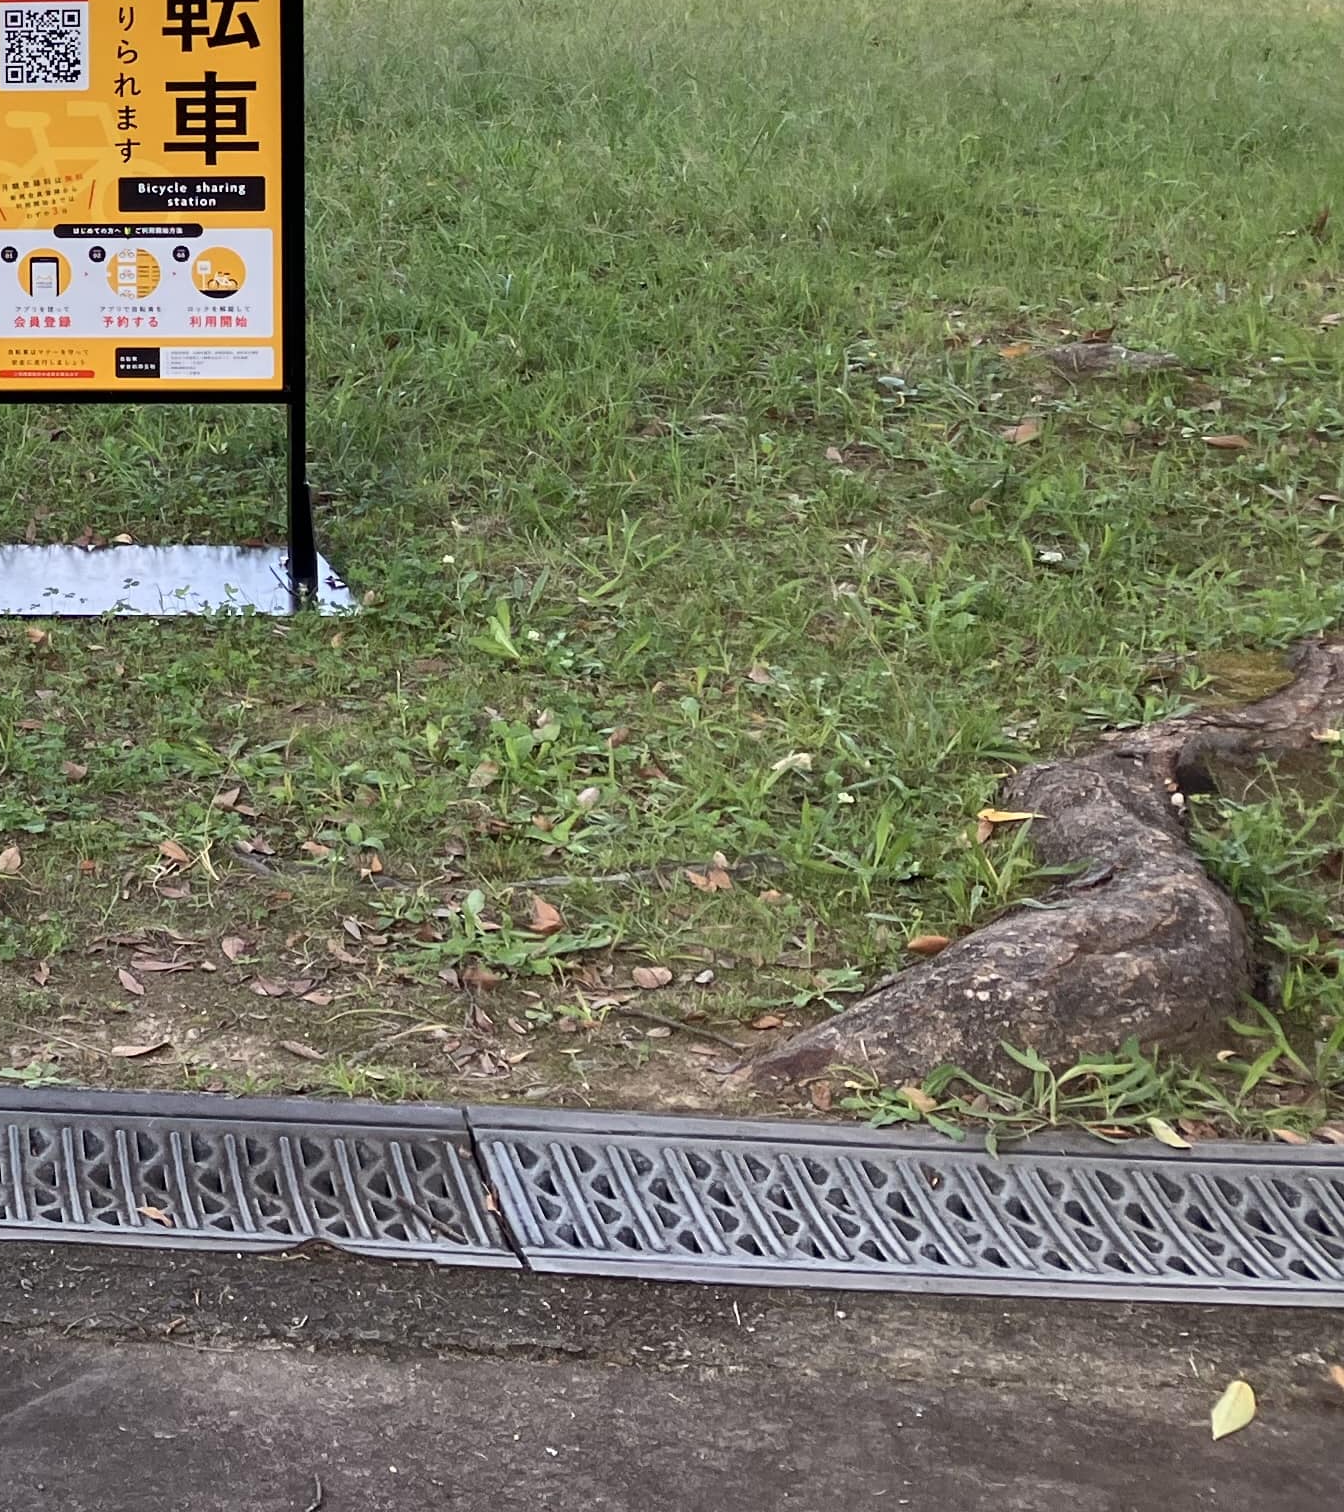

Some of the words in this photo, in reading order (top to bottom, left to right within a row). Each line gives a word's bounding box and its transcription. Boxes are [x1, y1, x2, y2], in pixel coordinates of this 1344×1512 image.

[138, 182, 188, 196] Bicycle
[195, 182, 246, 196] sharing
[167, 196, 217, 207] station
[14, 316, 71, 328] 会員登録
[102, 316, 159, 328] 予約する
[189, 315, 248, 328] 利用開始
